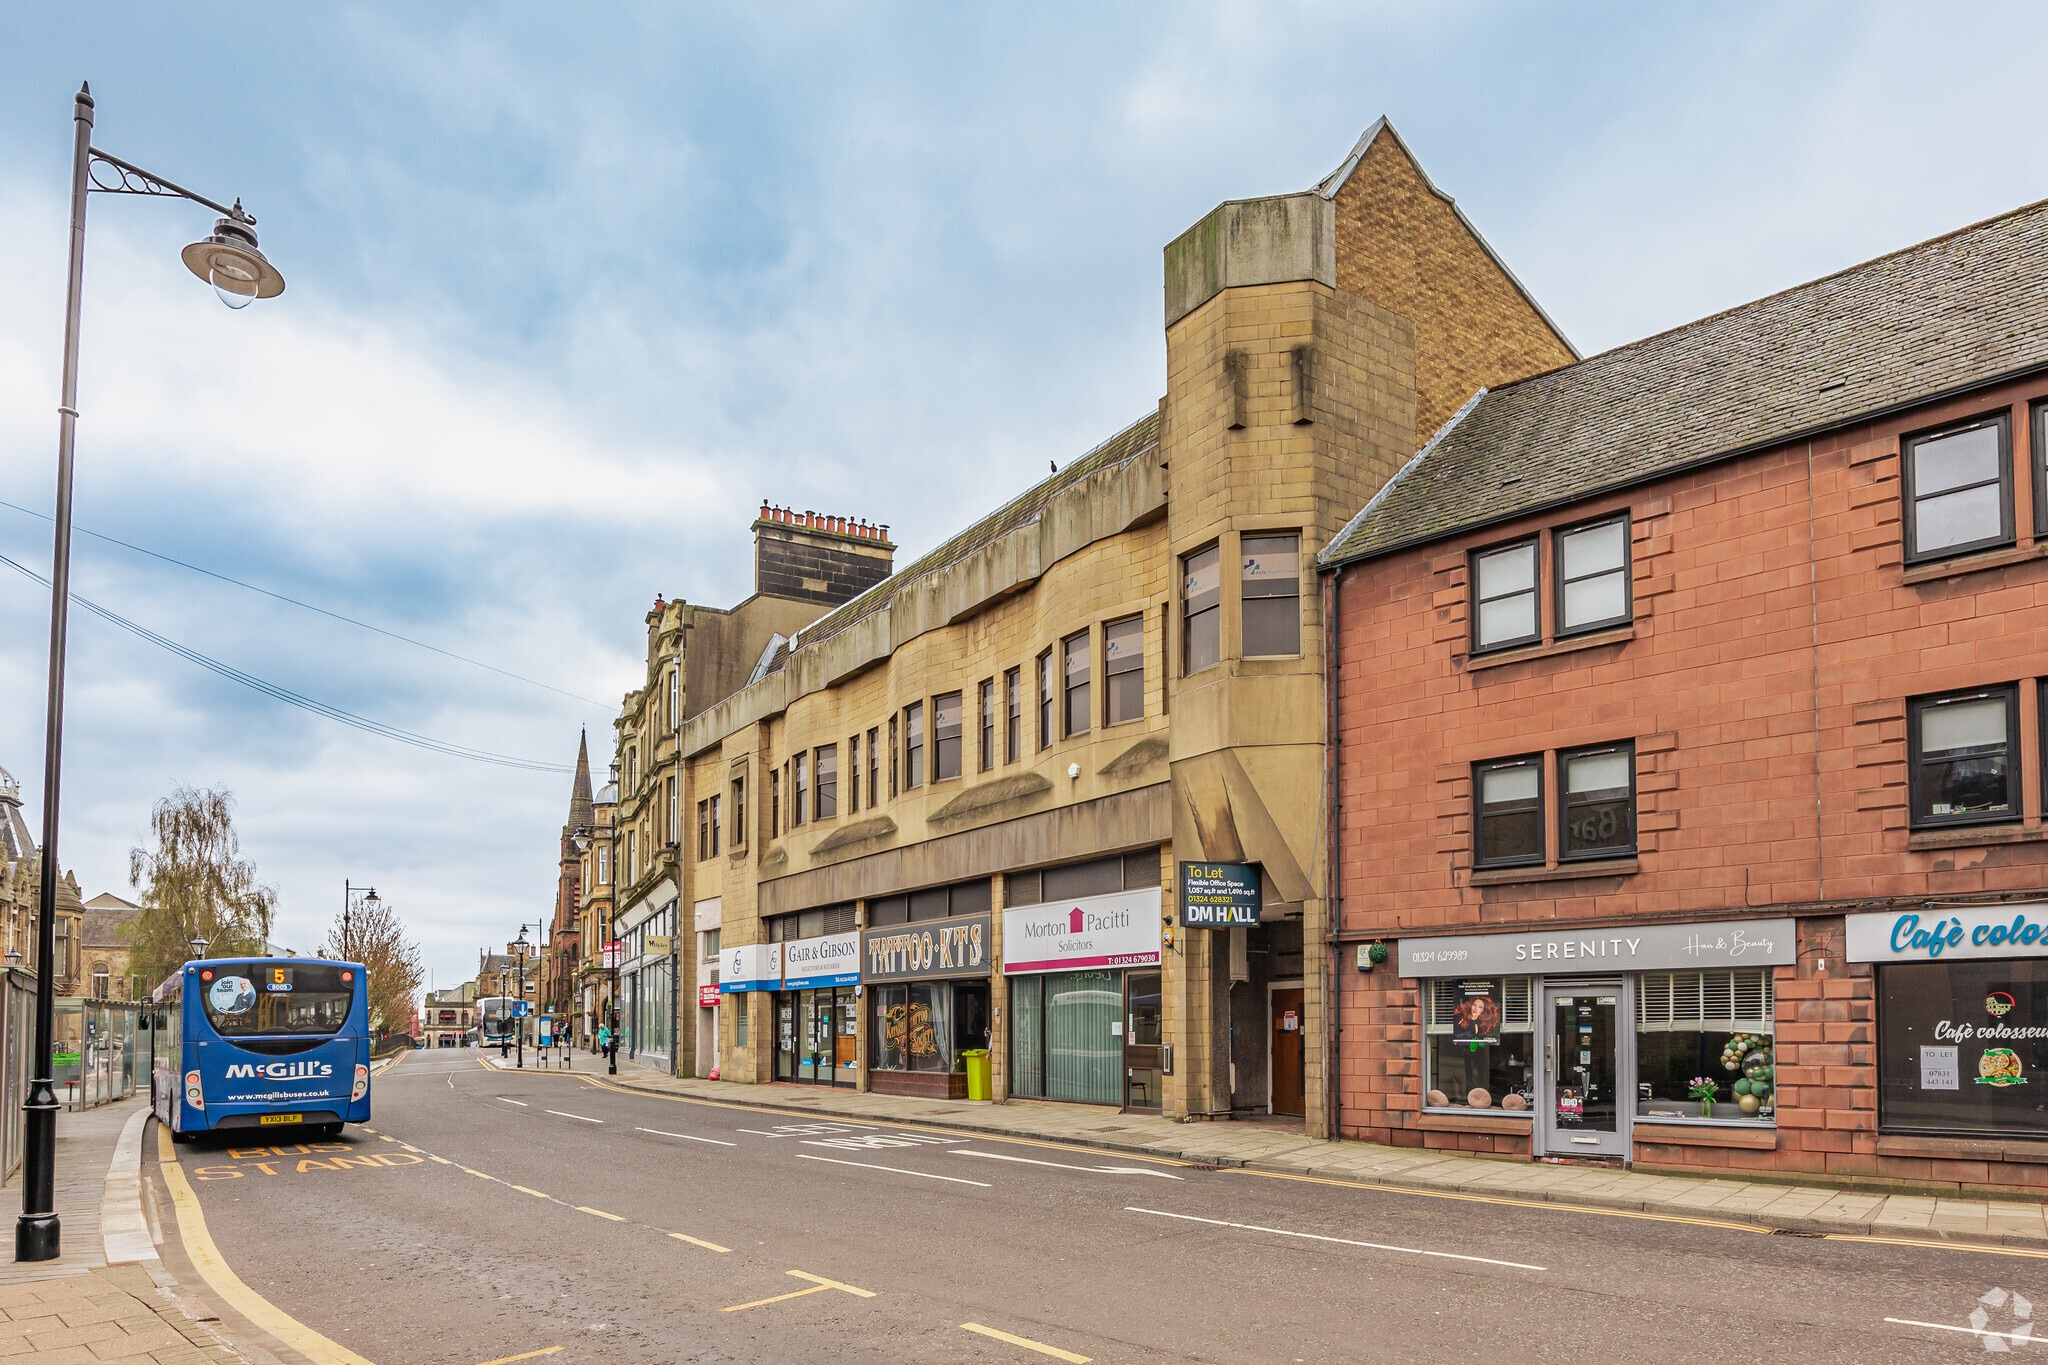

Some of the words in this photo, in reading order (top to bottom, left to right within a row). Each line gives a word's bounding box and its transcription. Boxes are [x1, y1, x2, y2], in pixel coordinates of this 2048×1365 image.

[1188, 866, 1202, 878] To
[1204, 866, 1223, 878] Let
[1188, 906, 1213, 922] DM
[1216, 906, 1256, 922] HALL
[1024, 920, 1066, 939] Morton
[1087, 909, 1130, 931] Pacitti
[812, 946, 818, 960] &
[820, 941, 856, 959] GIBSON
[868, 932, 934, 974] TATTOO
[940, 924, 982, 968] KTS
[1058, 940, 1093, 953] Solicitors
[1516, 938, 1641, 960] SERENITY
[1681, 934, 1713, 956] Hair
[1715, 937, 1727, 949] &
[1729, 930, 1774, 956] Beauty
[1108, 957, 1114, 965] T:
[1114, 956, 1132, 964] 01324
[1134, 955, 1156, 964] 679030
[1438, 950, 1468, 962] 629989
[274, 968, 286, 984] 5
[1976, 1023, 2048, 1040] colosseu
[226, 1061, 332, 1079] McGill's
[228, 1090, 330, 1101] www.mcgillsbuses.co.uk
[227, 1142, 353, 1160] BUS
[194, 1154, 424, 1180] STAND
